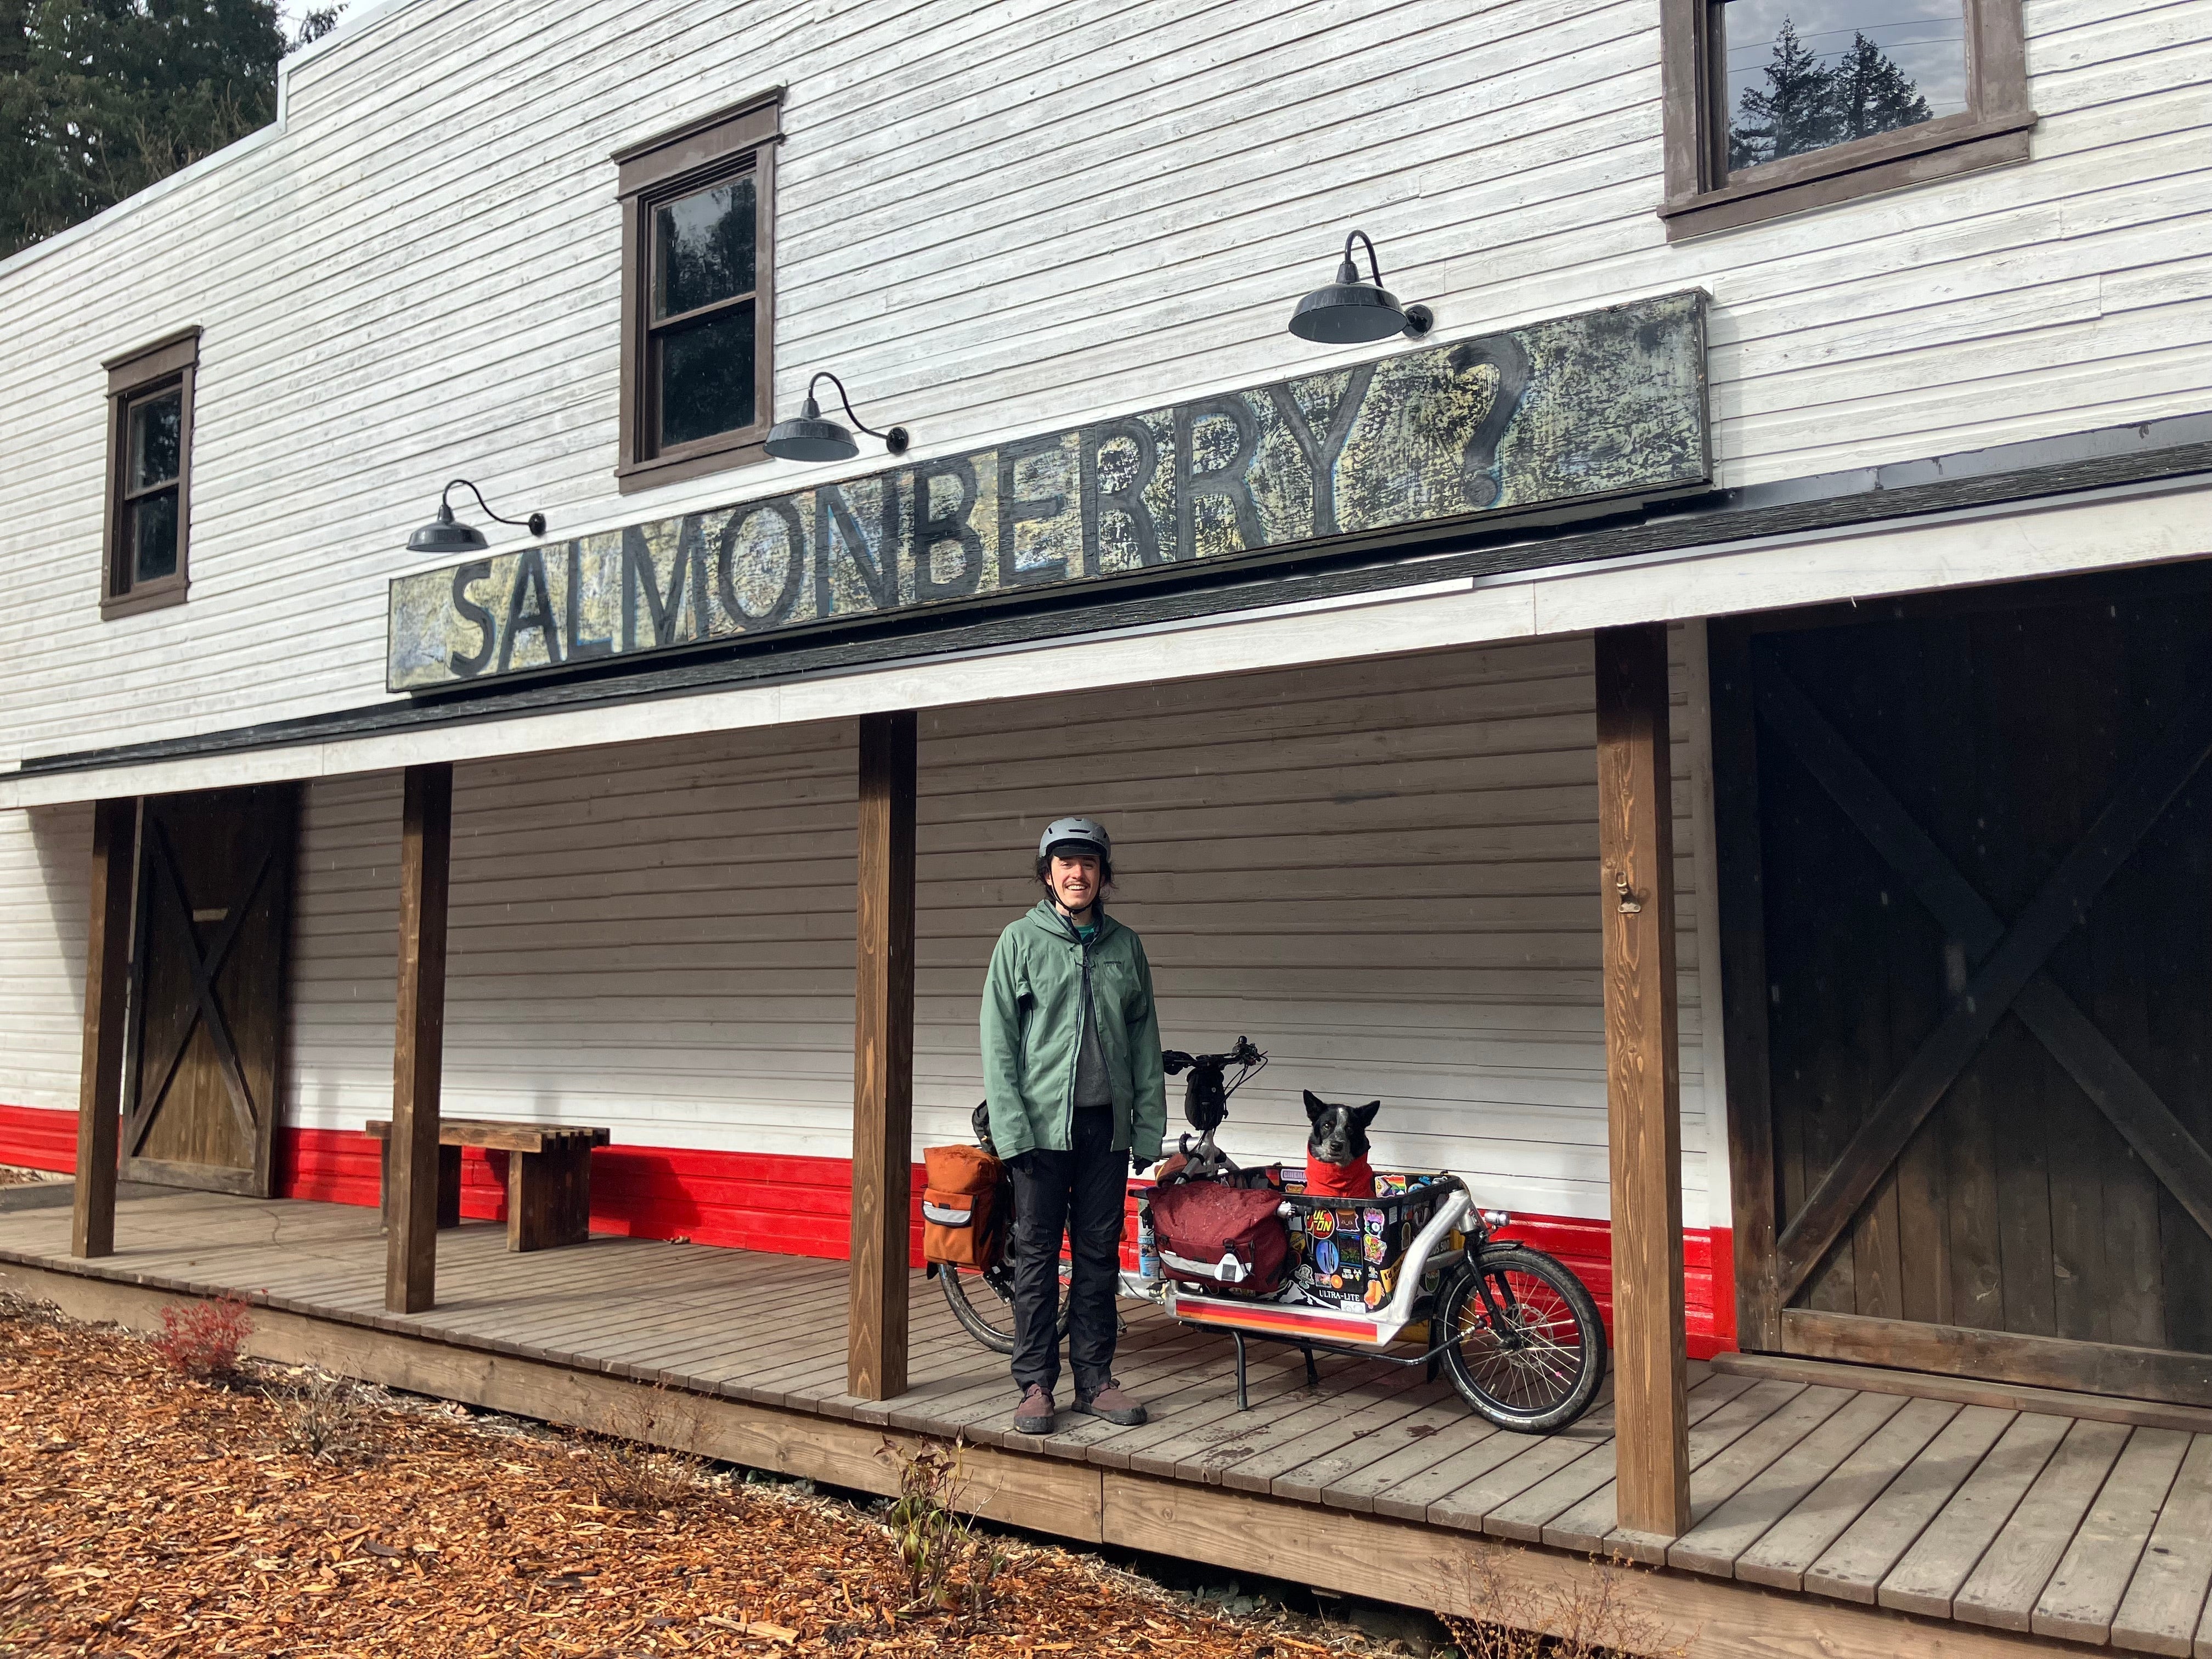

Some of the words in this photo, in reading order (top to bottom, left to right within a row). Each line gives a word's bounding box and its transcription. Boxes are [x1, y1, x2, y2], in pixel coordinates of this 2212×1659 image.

[450, 361, 1377, 677] SALMONBERRY
[1449, 334, 1529, 508] ?
[1319, 1290, 1360, 1302] ULTRA-LITE
